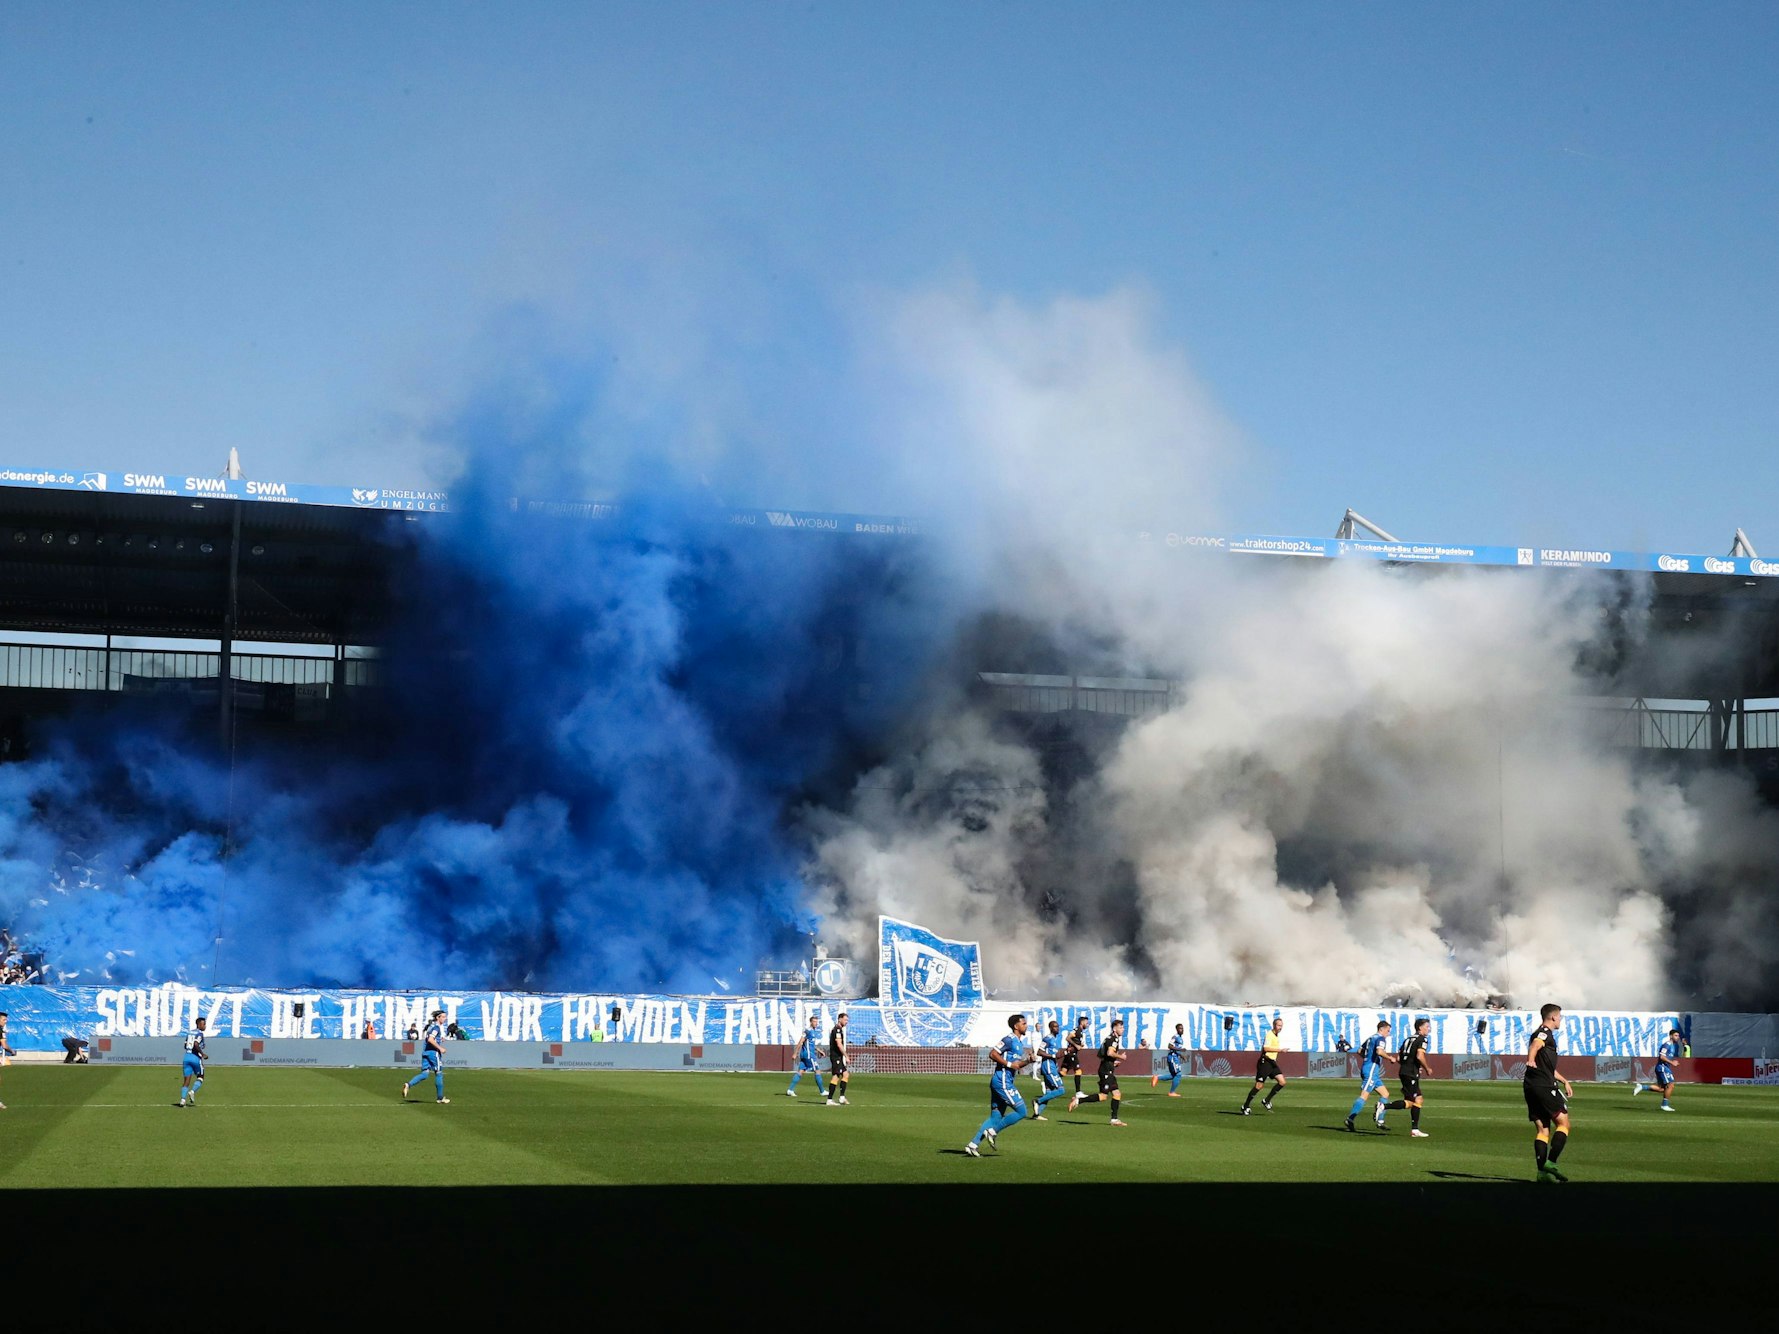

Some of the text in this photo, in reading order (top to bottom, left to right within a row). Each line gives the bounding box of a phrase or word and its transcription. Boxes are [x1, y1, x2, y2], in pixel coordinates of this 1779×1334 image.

[123, 473, 165, 488] SWM
[185, 477, 226, 492] SWM
[246, 481, 287, 496] SWM
[382, 489, 448, 501] ENGELMANN
[795, 517, 838, 530] WOBAU
[855, 522, 894, 534] BADEN
[1413, 546, 1434, 554] GmbH
[1435, 547, 1474, 556] Magdeburg
[1541, 549, 1611, 563] KERAMUNDO
[95, 982, 249, 1038] SCHÜTZT
[270, 994, 321, 1039] DIE
[481, 991, 544, 1042] VOR
[561, 996, 707, 1044] FREMDEN
[1188, 1006, 1280, 1052] VORAN
